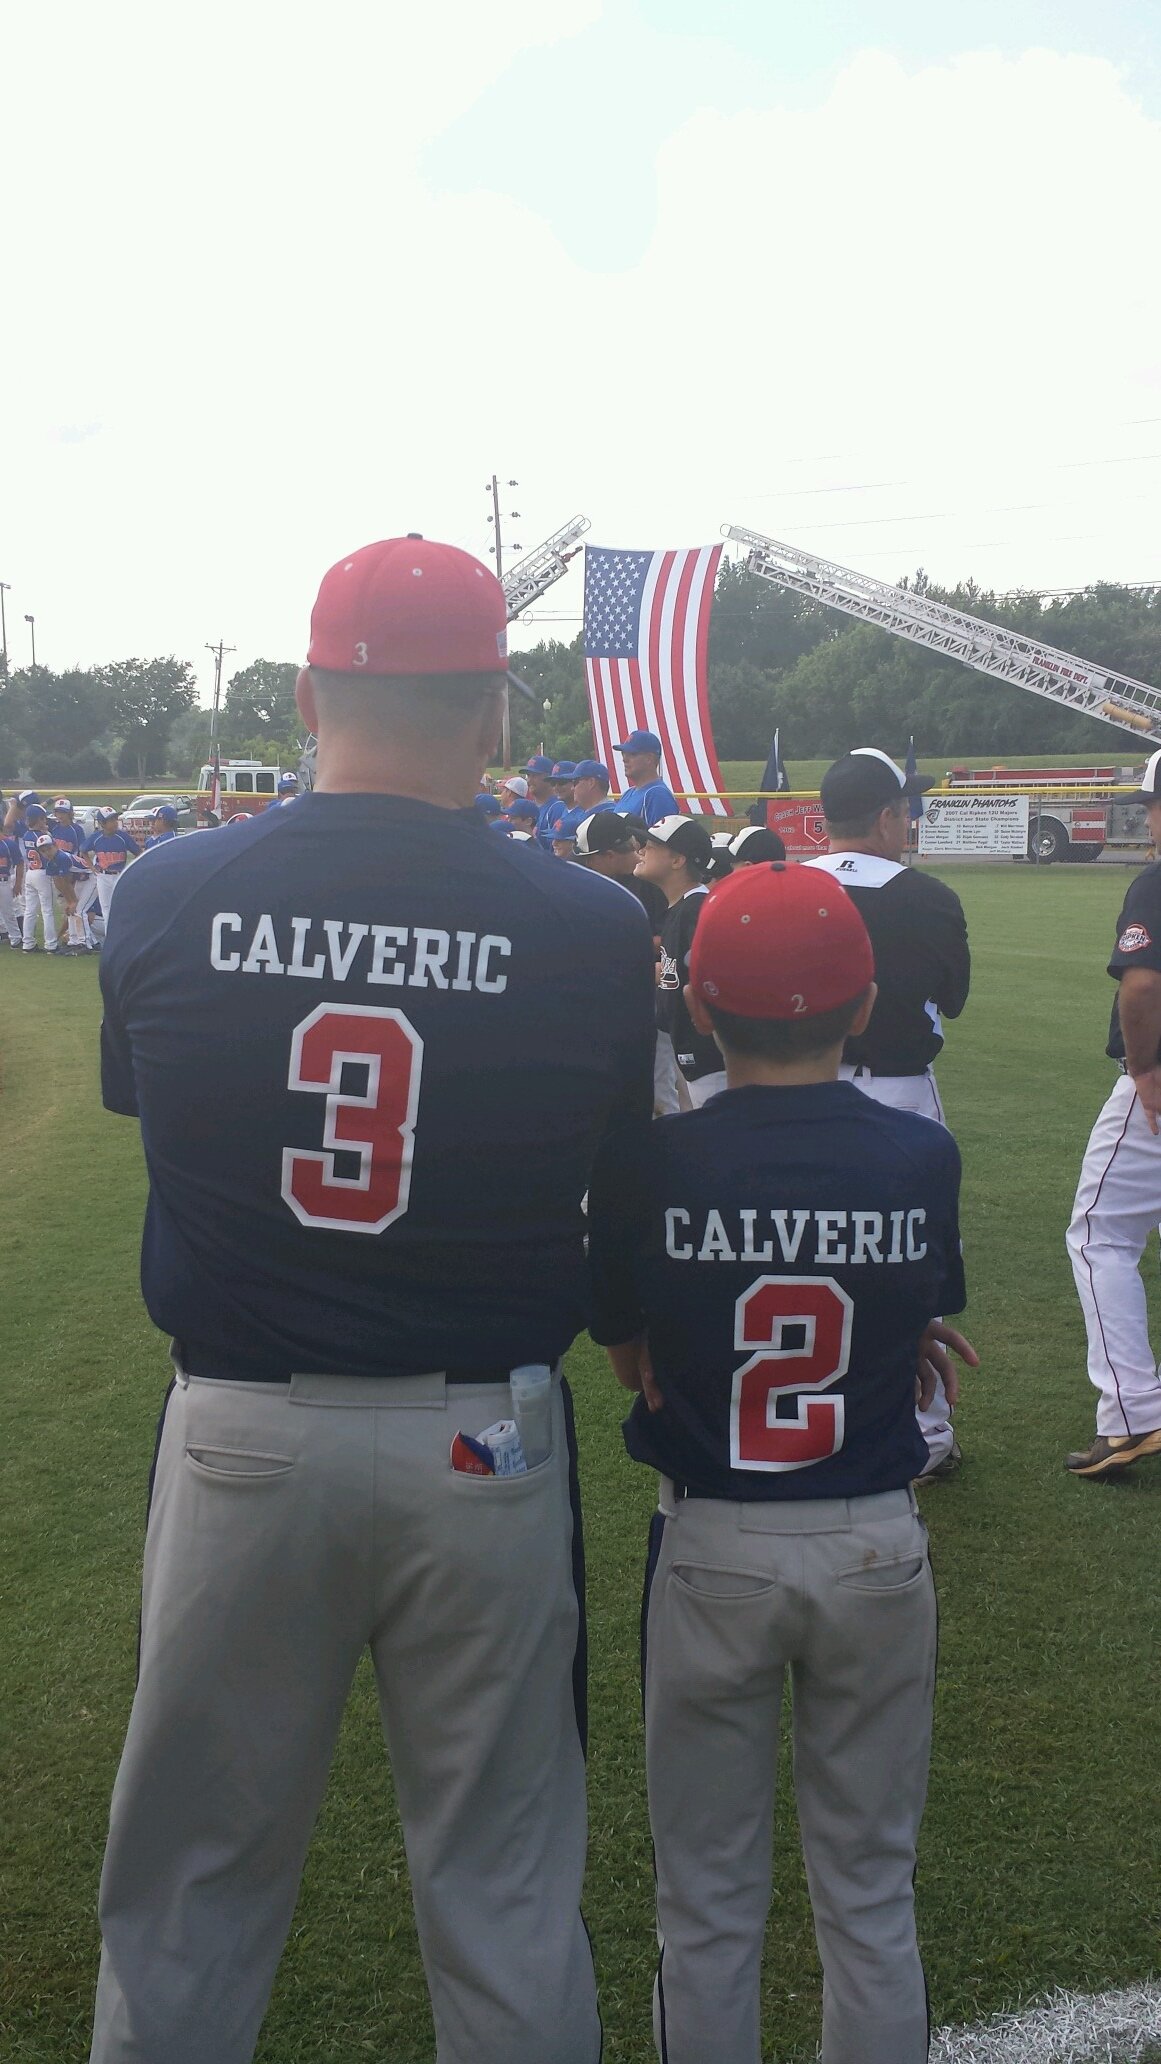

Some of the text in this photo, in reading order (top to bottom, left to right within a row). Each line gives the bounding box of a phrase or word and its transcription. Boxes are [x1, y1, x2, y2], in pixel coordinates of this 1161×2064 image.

[352, 641, 368, 666] 3
[1032, 655, 1060, 673] FRANKLIN
[1060, 667, 1073, 678] FIRE
[795, 805, 811, 815] JEFF
[929, 798, 1018, 809] FRANKLIN PHANTOMS
[814, 821, 823, 834] 5
[210, 911, 512, 994] CALVERIC
[791, 994, 808, 1012] 2
[281, 1001, 425, 1235] 3
[664, 1207, 927, 1264] CALVERIC
[730, 1274, 855, 1472] 2
